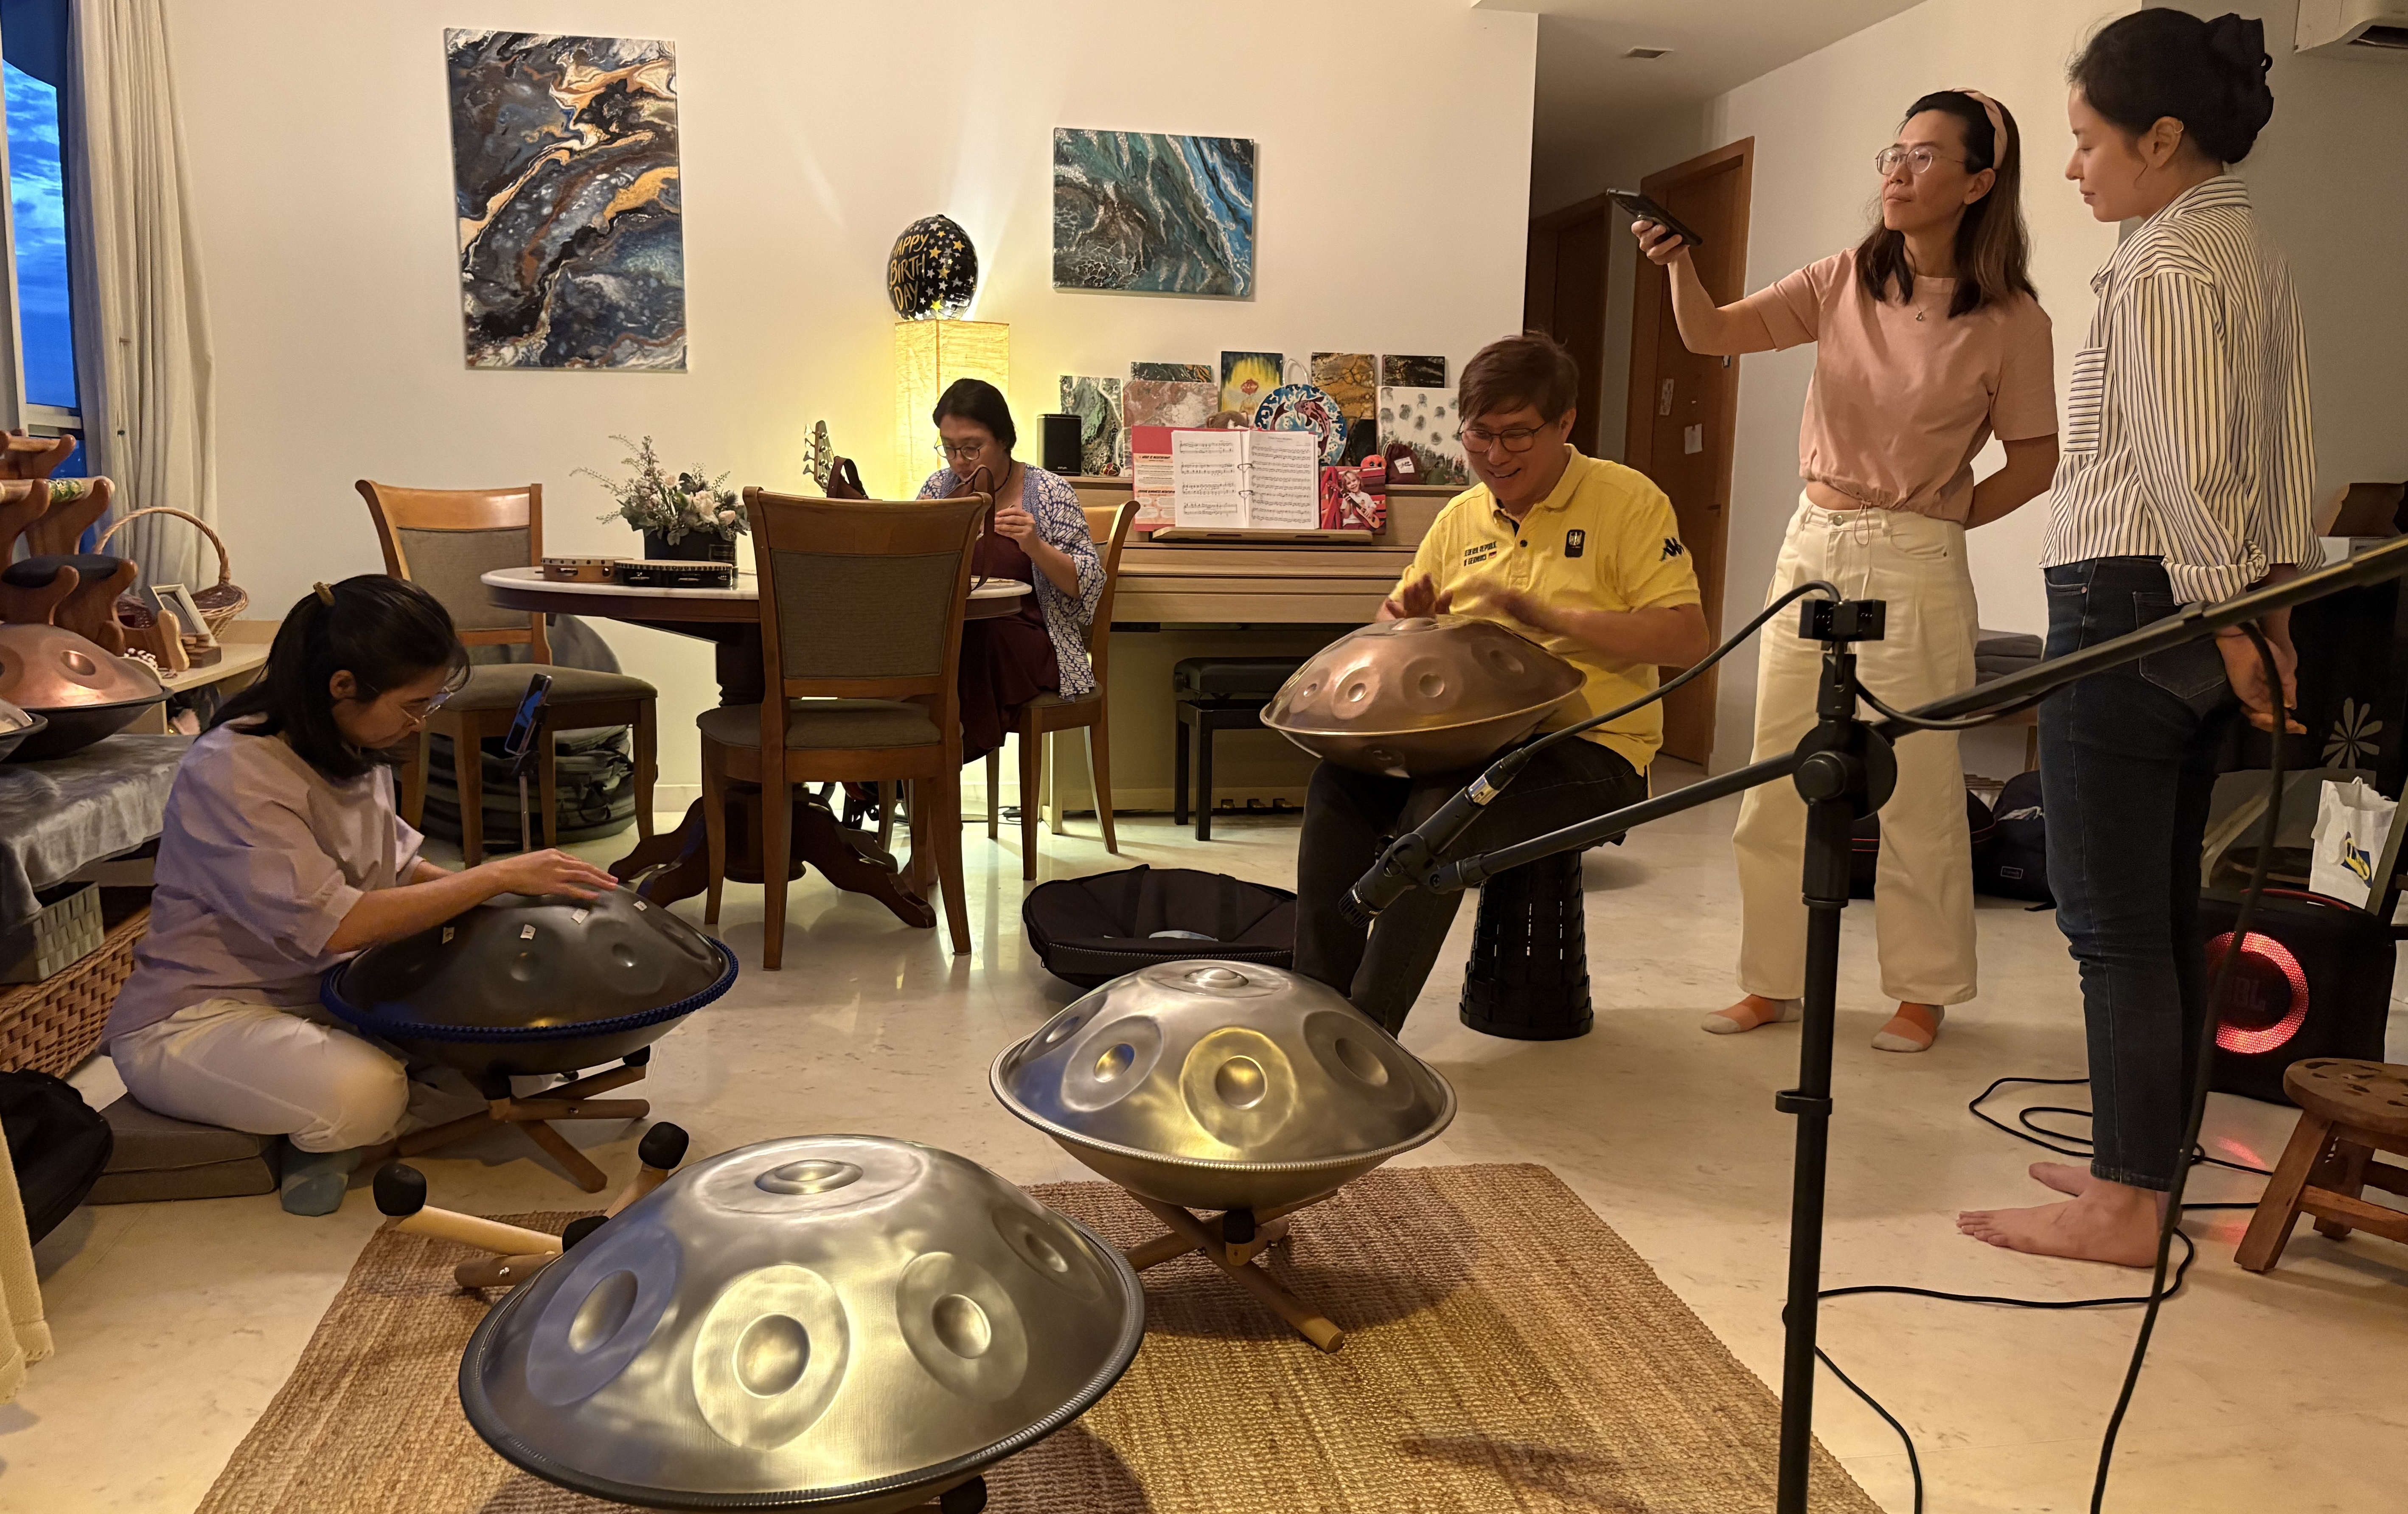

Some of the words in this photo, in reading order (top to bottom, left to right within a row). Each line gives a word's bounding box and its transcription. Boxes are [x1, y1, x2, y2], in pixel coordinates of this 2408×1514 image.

[891, 233, 929, 258] HAPPY
[890, 253, 925, 290] BIRTH
[894, 280, 919, 312] DAY
